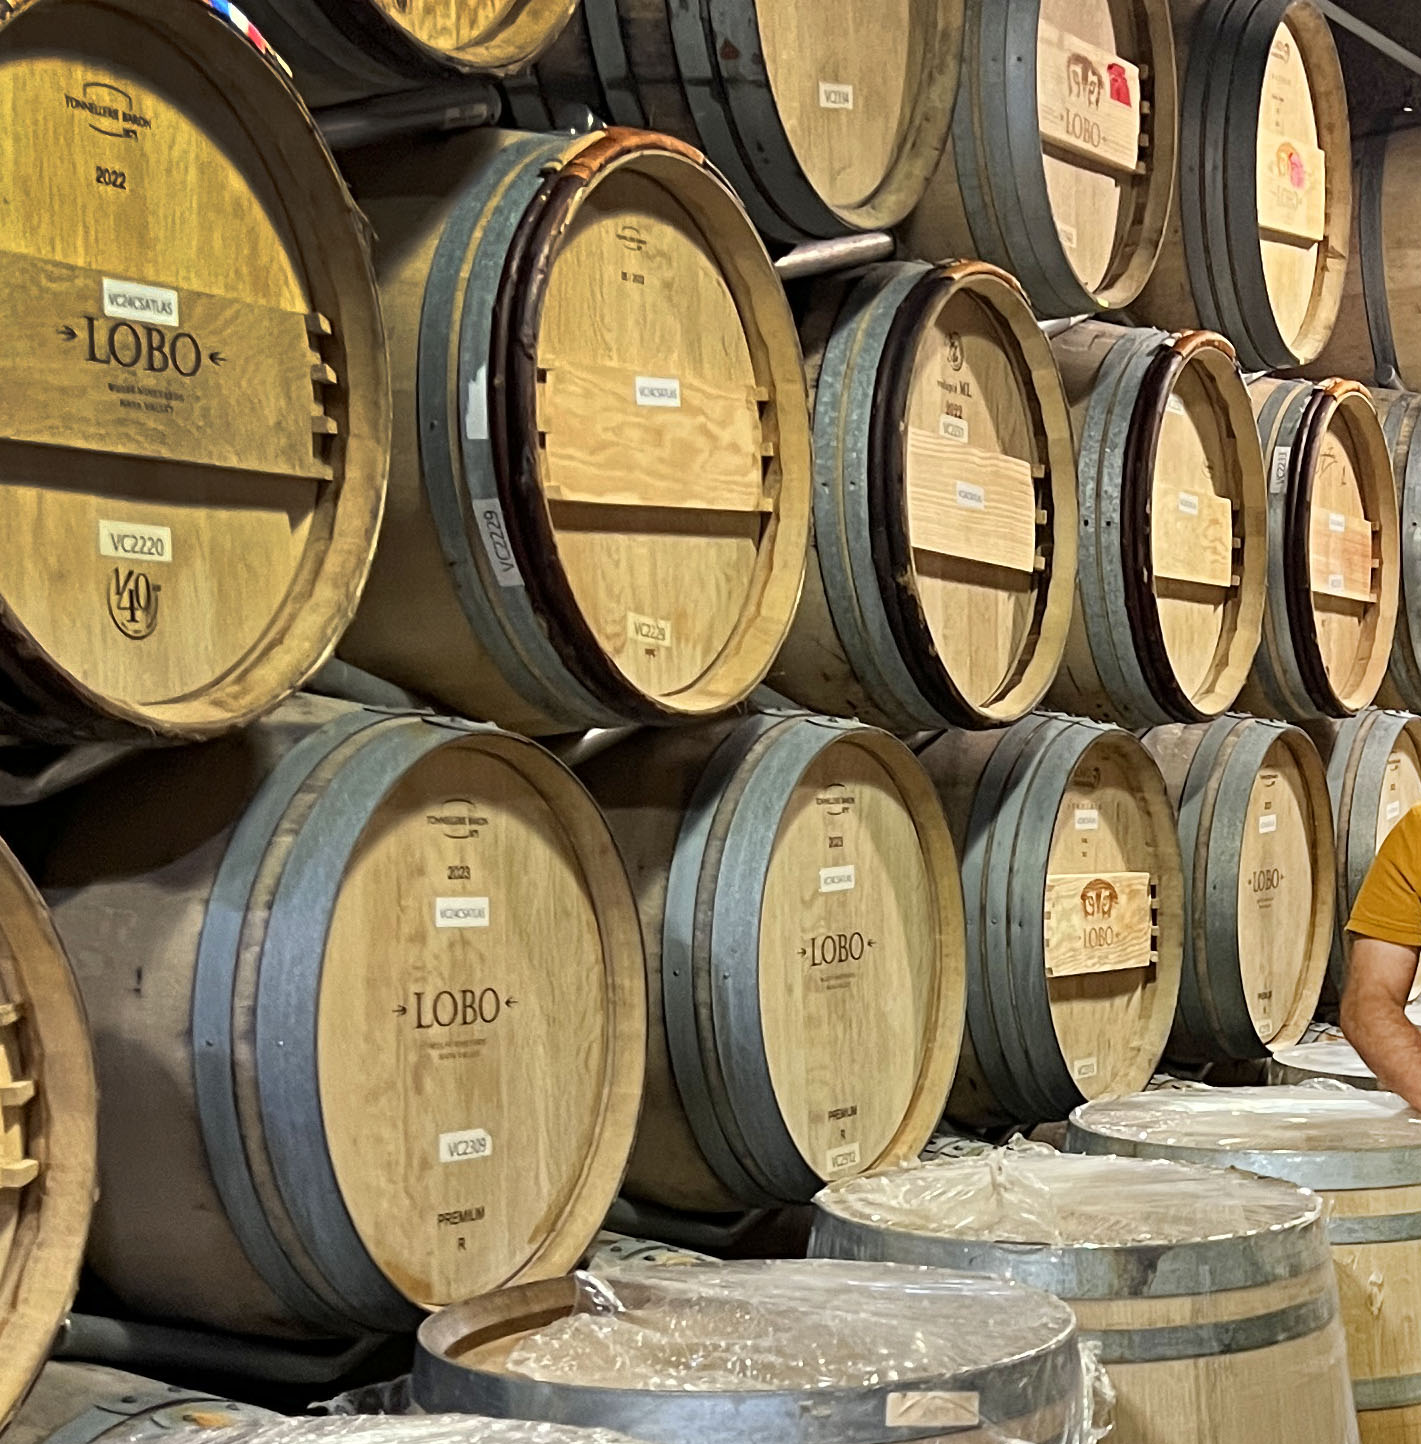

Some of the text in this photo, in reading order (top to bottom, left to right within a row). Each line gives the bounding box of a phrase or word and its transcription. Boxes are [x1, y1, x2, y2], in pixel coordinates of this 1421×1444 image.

[1065, 108, 1101, 149] LOBO
[96, 165, 127, 191] 2022
[83, 315, 203, 378] LOBO
[110, 532, 165, 557] VC2220
[483, 510, 515, 573] VC2229
[1253, 868, 1280, 893] LOBO
[811, 931, 864, 967] LOBO
[1083, 925, 1114, 949] LOBO
[413, 987, 500, 1029] LOBO
[437, 1206, 485, 1226] PREMIUM
[457, 1236, 466, 1251] R
